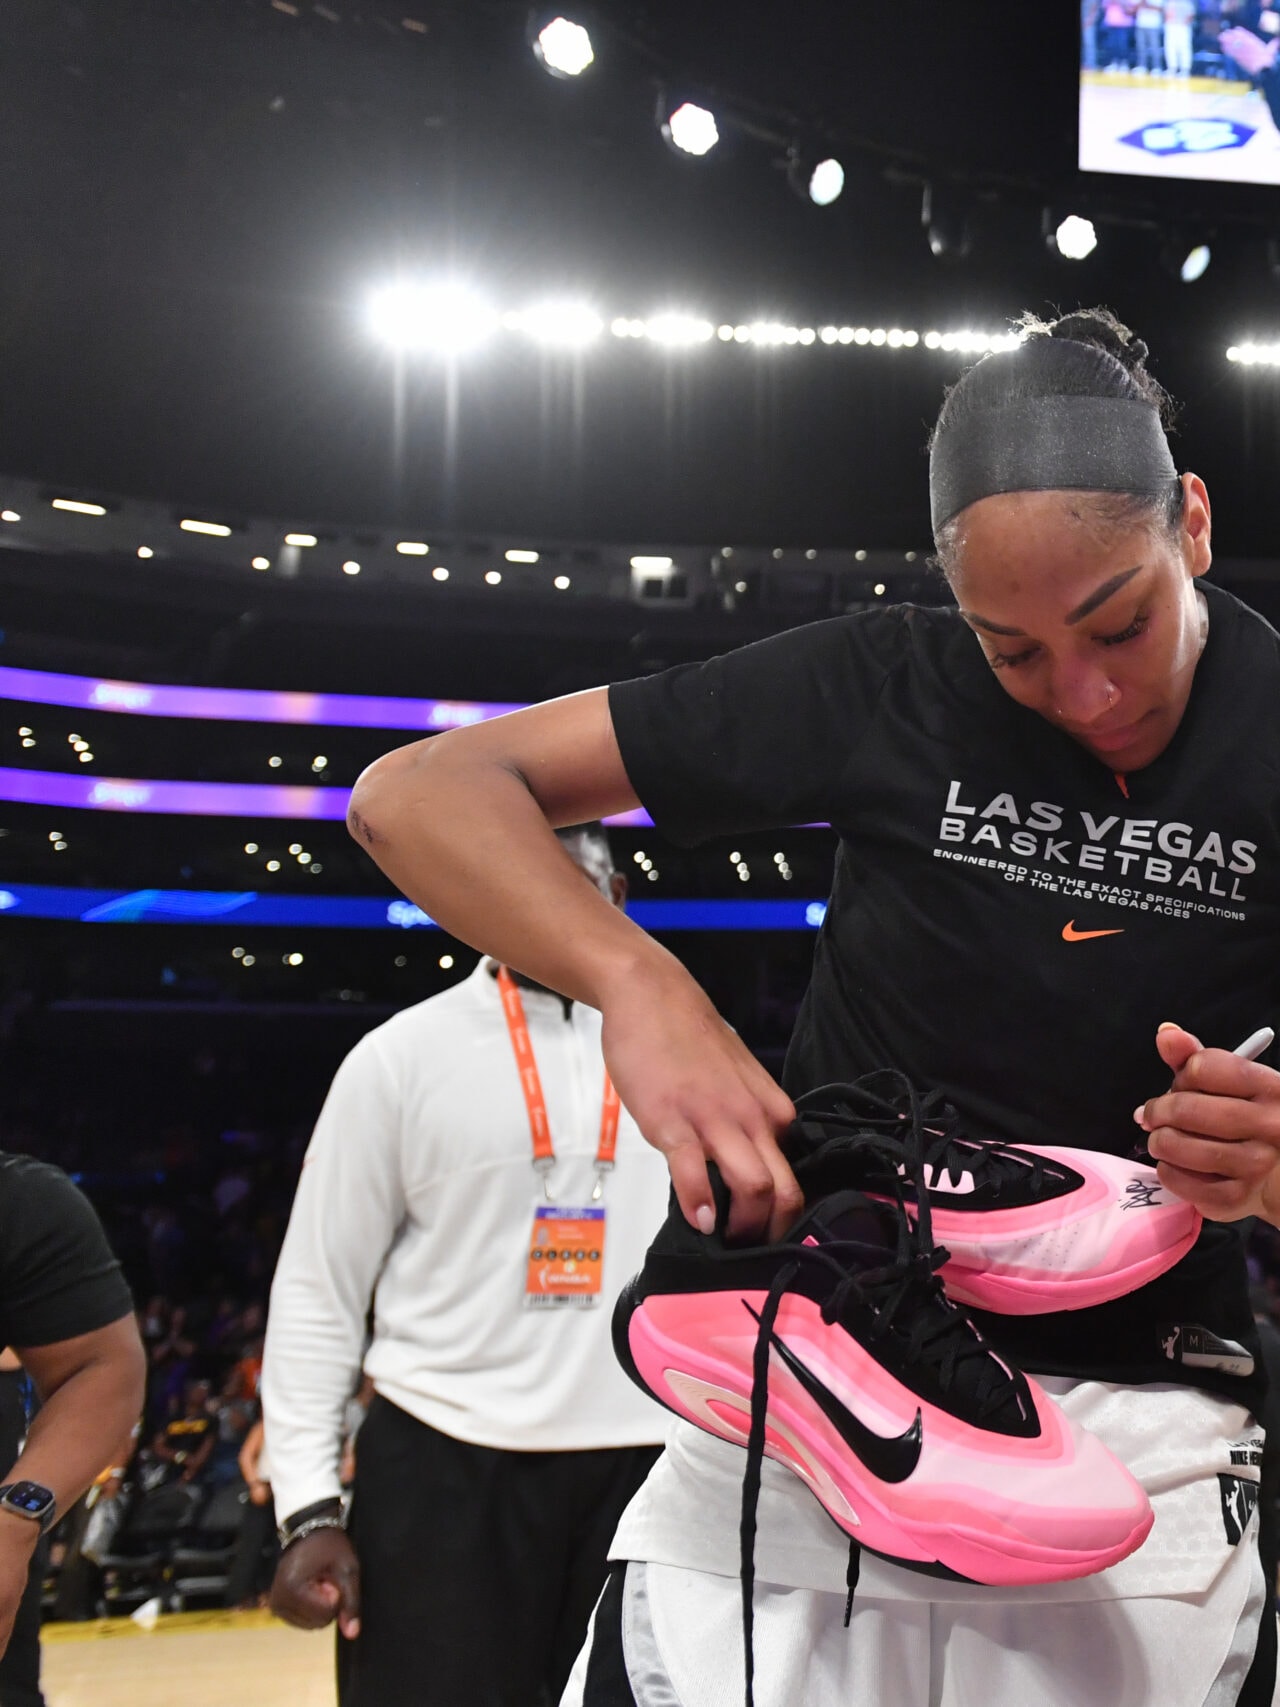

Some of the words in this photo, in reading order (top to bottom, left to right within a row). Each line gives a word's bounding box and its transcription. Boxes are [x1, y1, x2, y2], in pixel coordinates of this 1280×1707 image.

[939, 817, 1247, 902] BASKETBALL
[945, 780, 1065, 832] LAS
[1080, 811, 1258, 875] VEGAS
[933, 848, 1028, 876] ENGINEERED
[1032, 869, 1053, 881] TO
[1057, 875, 1087, 889] THE
[1090, 882, 1142, 899] EXACT
[1145, 893, 1246, 921] SPECIFICATIONS
[1003, 872, 1026, 883] OF
[1029, 877, 1059, 892] THE
[1062, 886, 1093, 900] LAS
[1098, 893, 1149, 911] VEGAS
[1153, 904, 1191, 919] ACES
